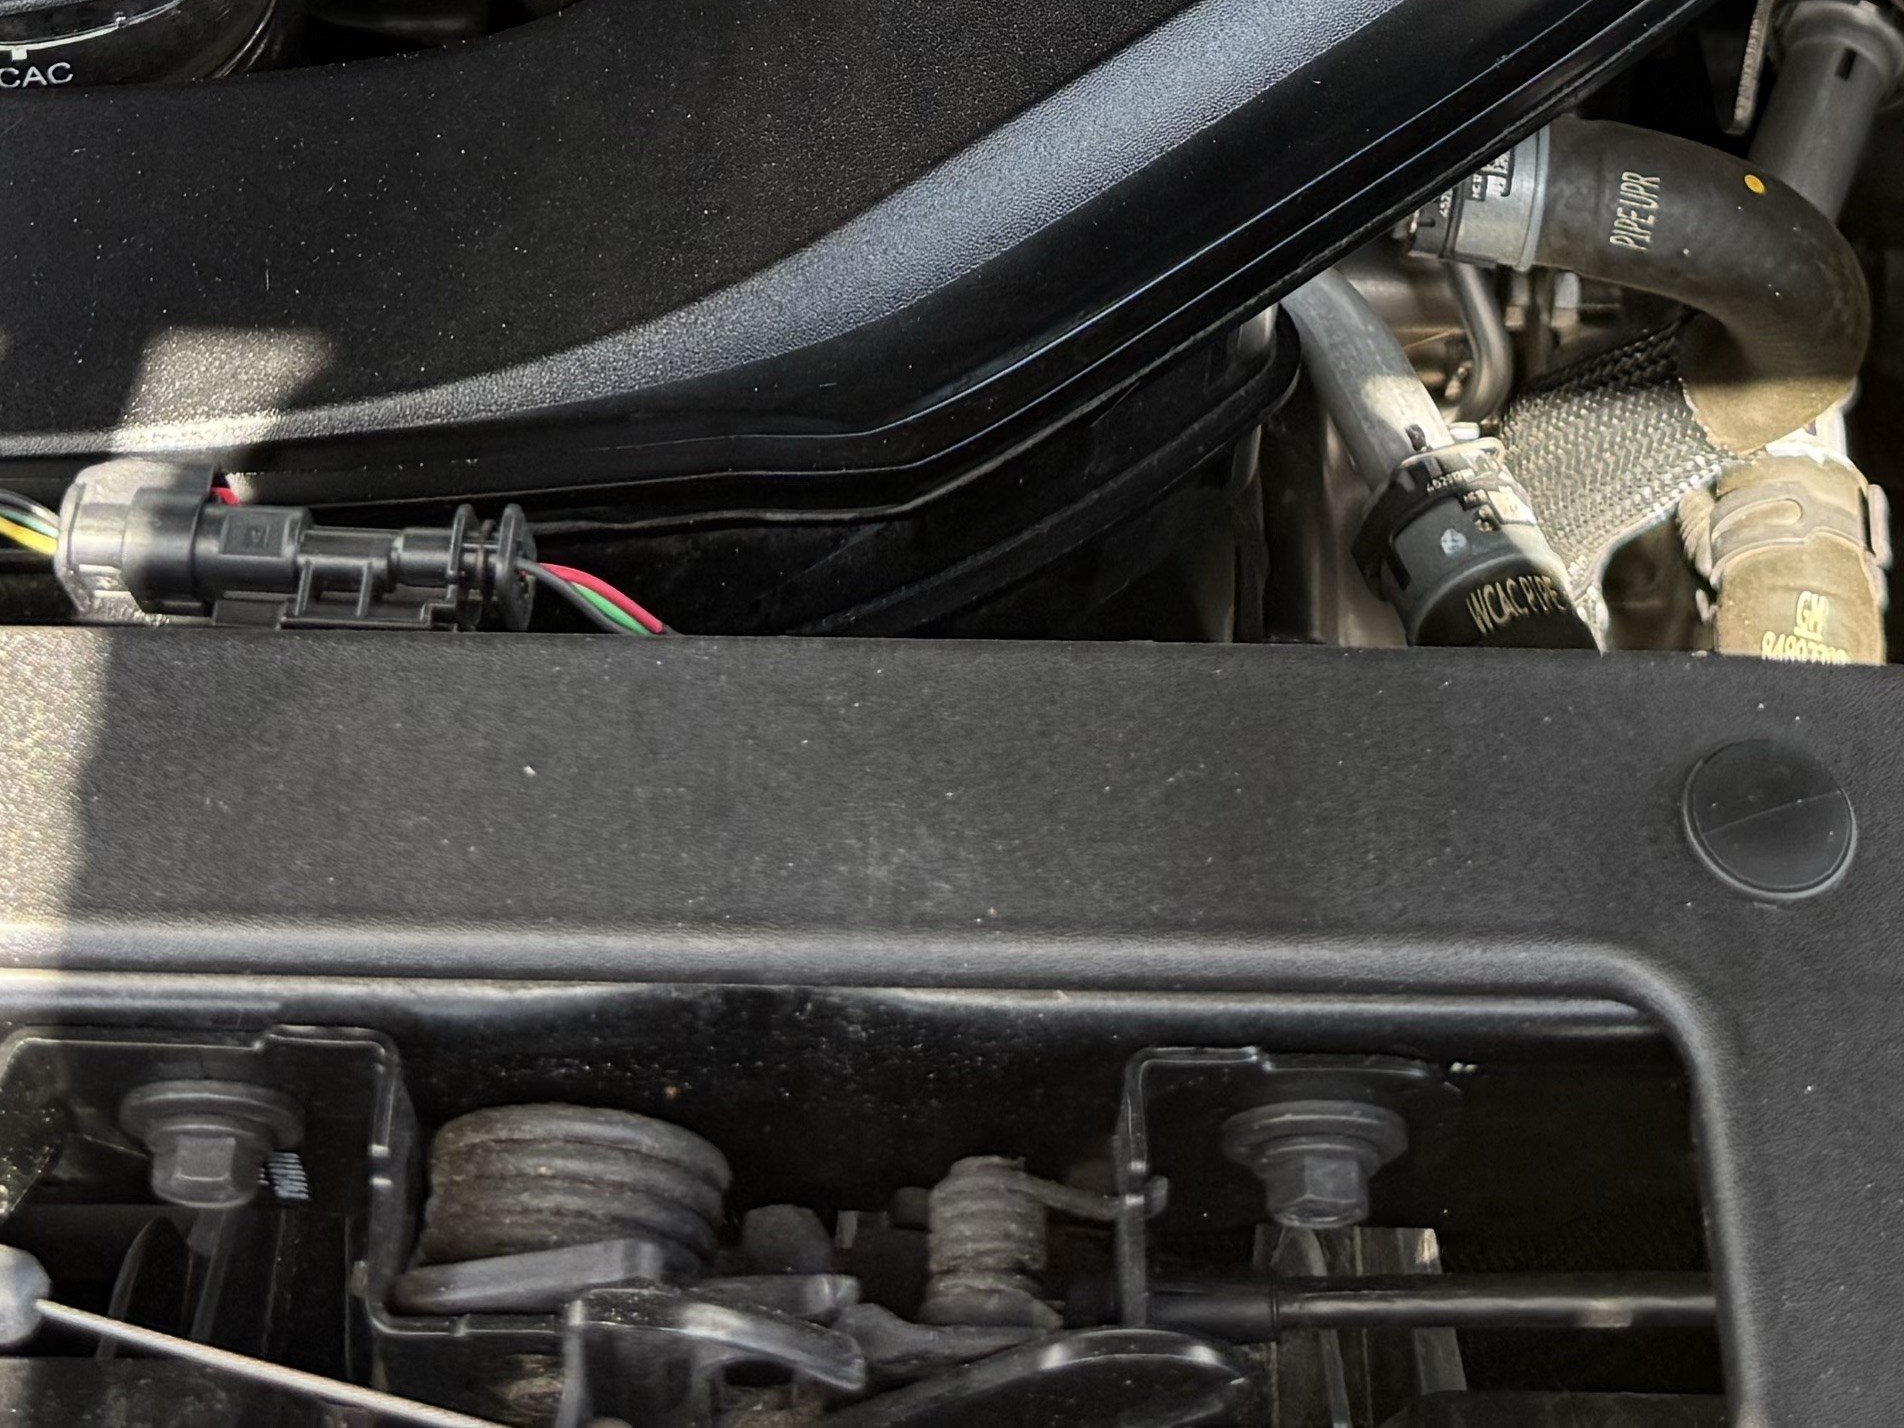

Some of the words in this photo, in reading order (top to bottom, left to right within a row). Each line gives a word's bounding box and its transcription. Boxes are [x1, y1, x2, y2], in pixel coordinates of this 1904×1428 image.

[1618, 170, 1662, 210] UPR
[1609, 206, 1656, 251] PIPE
[1518, 575, 1569, 613] PIPE
